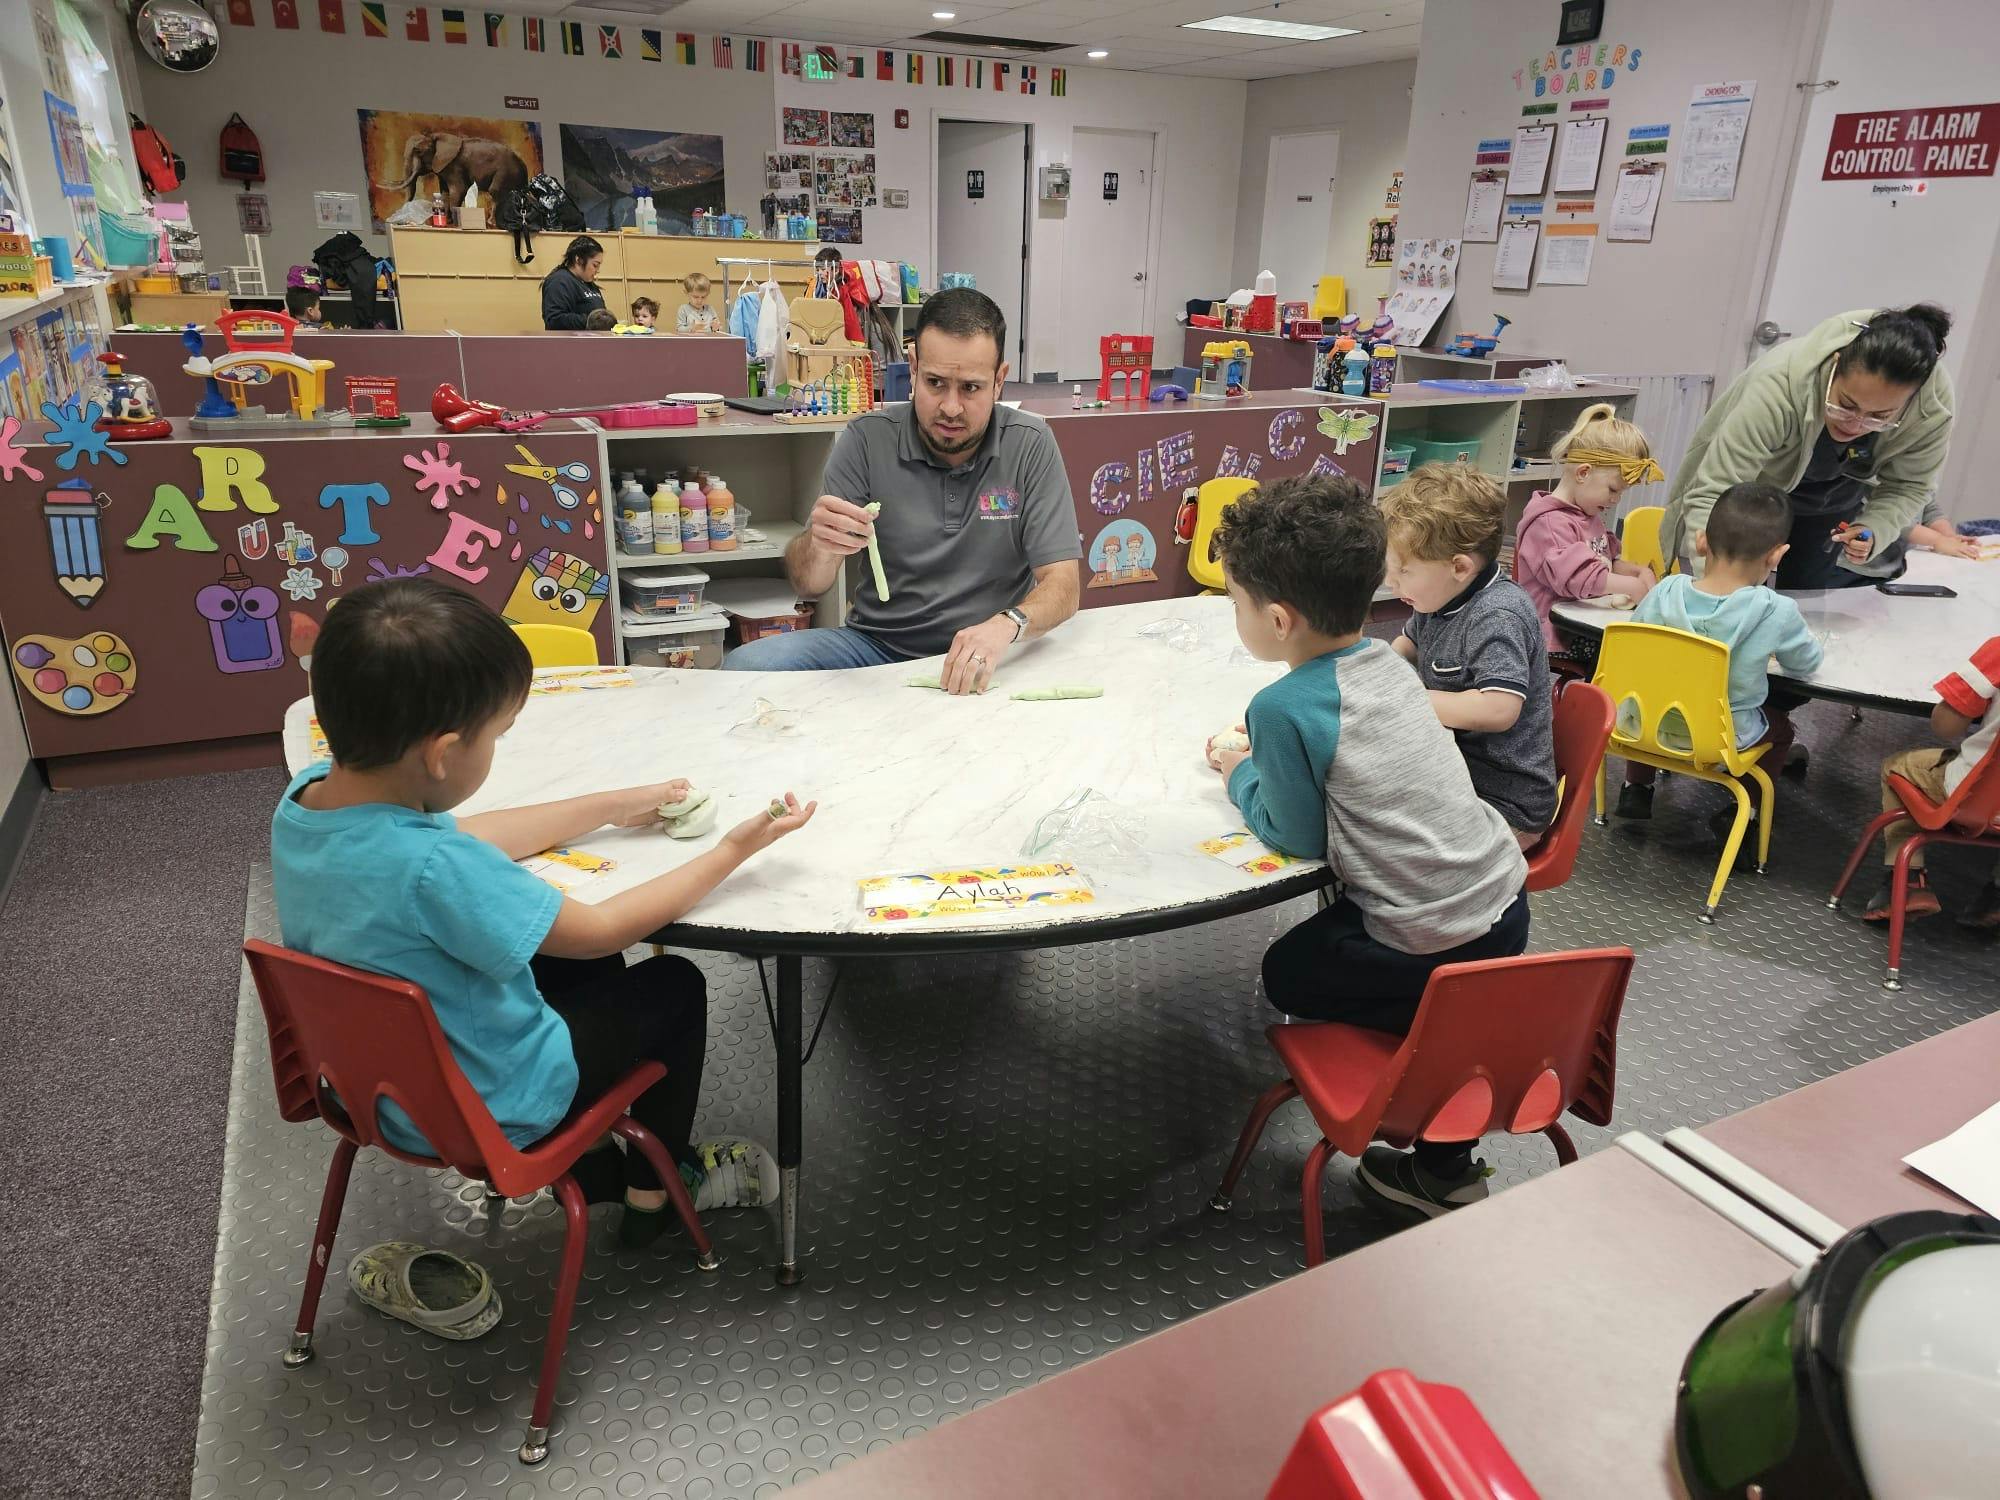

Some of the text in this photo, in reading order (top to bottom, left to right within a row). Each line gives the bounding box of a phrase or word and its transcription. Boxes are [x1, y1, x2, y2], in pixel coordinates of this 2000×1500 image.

[1512, 44, 1642, 91] TEACHERS
[1535, 68, 1615, 97] BOARD
[518, 99, 537, 107] EXIT
[1855, 111, 1981, 144] FIRE ALARM
[1830, 144, 1990, 175] CONTROL PANEL
[1872, 184, 1914, 195] Employees Only
[936, 881, 1022, 905] Aylah
